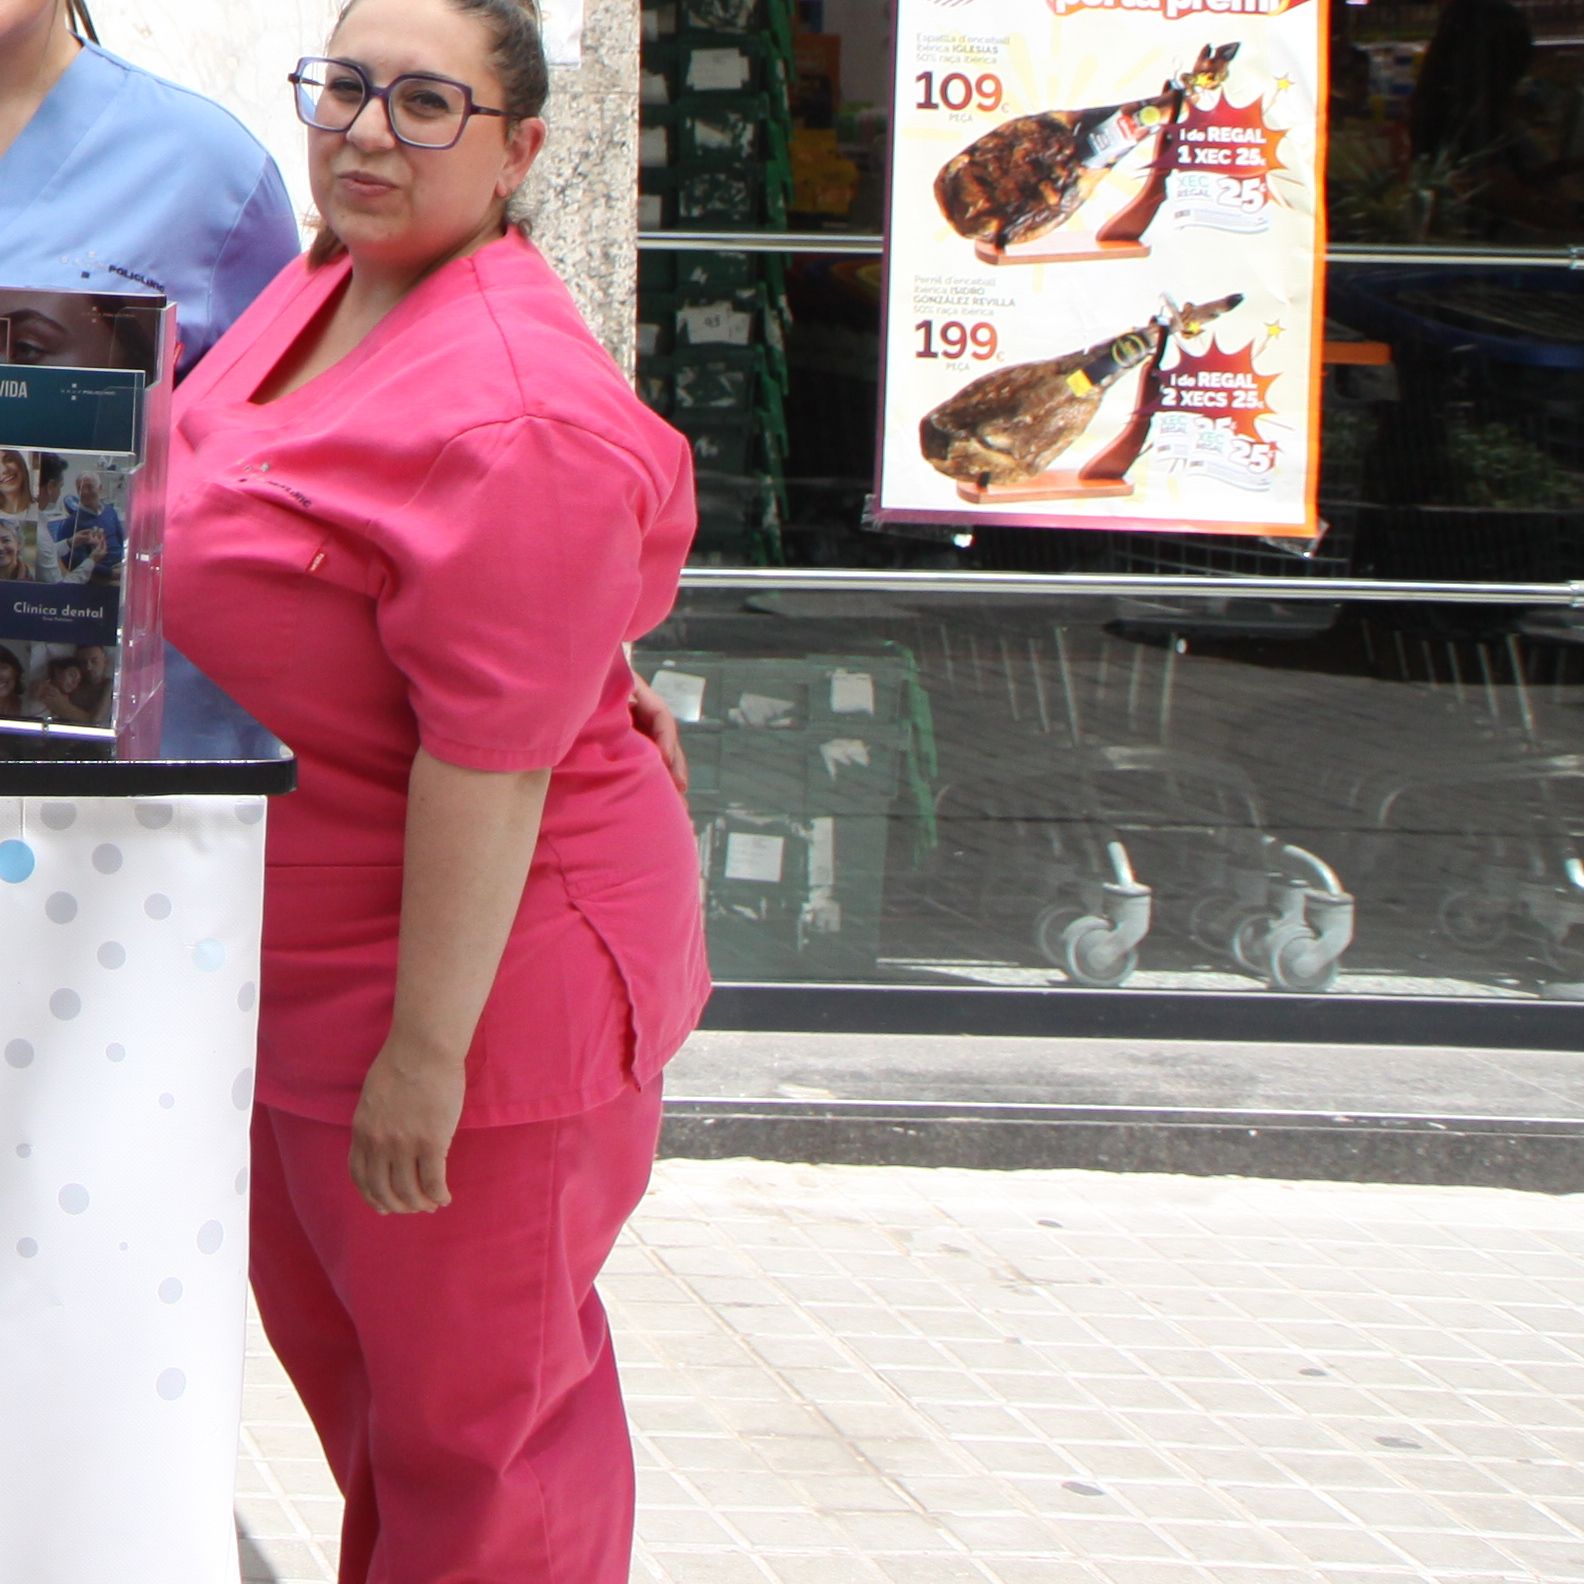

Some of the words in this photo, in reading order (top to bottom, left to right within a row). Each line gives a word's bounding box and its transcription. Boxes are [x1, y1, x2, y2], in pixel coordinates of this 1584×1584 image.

[1207, 126, 1267, 144] REGAL
[1194, 148, 1232, 164] XEC
[1198, 372, 1258, 388] REGAL
[1161, 387, 1177, 406] 2
[1180, 391, 1229, 407] XECS
[61, 602, 104, 619] dental
